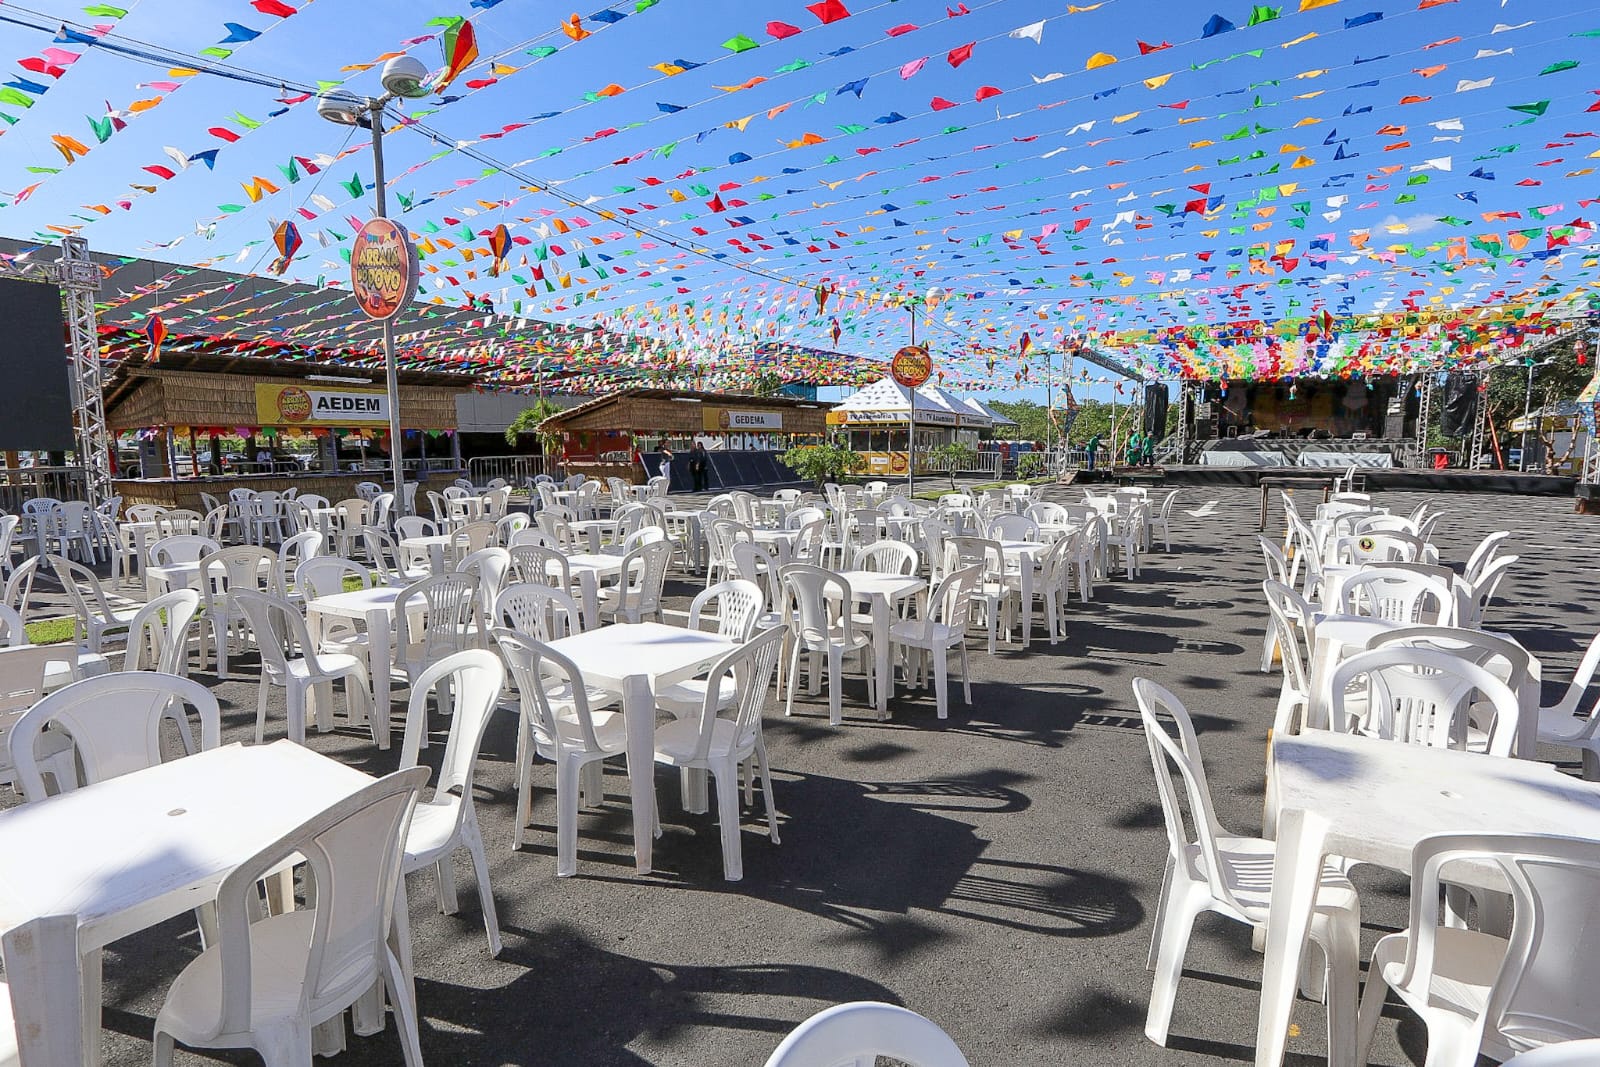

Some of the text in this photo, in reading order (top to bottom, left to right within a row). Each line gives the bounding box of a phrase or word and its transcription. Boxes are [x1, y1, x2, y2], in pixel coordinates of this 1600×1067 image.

[357, 268, 401, 291] DO POVO
[317, 396, 380, 411] AEDEM
[735, 415, 765, 425] GEDEMA
